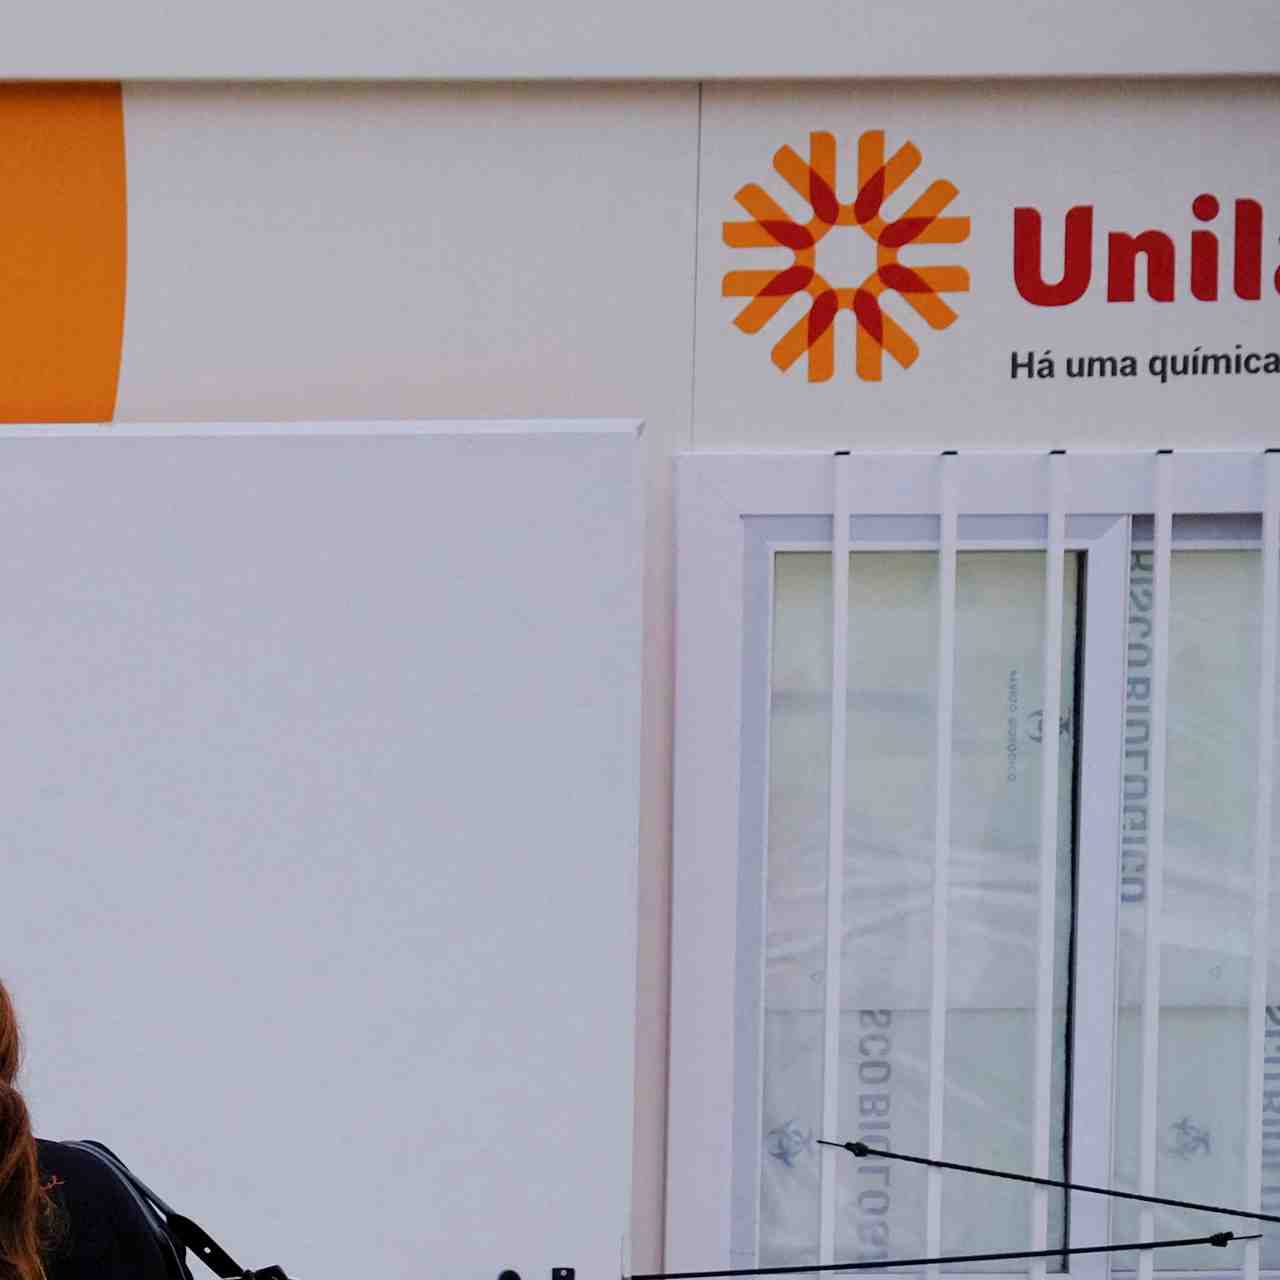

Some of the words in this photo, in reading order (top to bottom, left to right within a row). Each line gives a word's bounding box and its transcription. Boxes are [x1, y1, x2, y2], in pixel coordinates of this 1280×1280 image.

[1013, 193, 1280, 307] Unil
[1010, 350, 1055, 379] Há
[1066, 354, 1138, 378] uma
[1148, 344, 1280, 384] química
